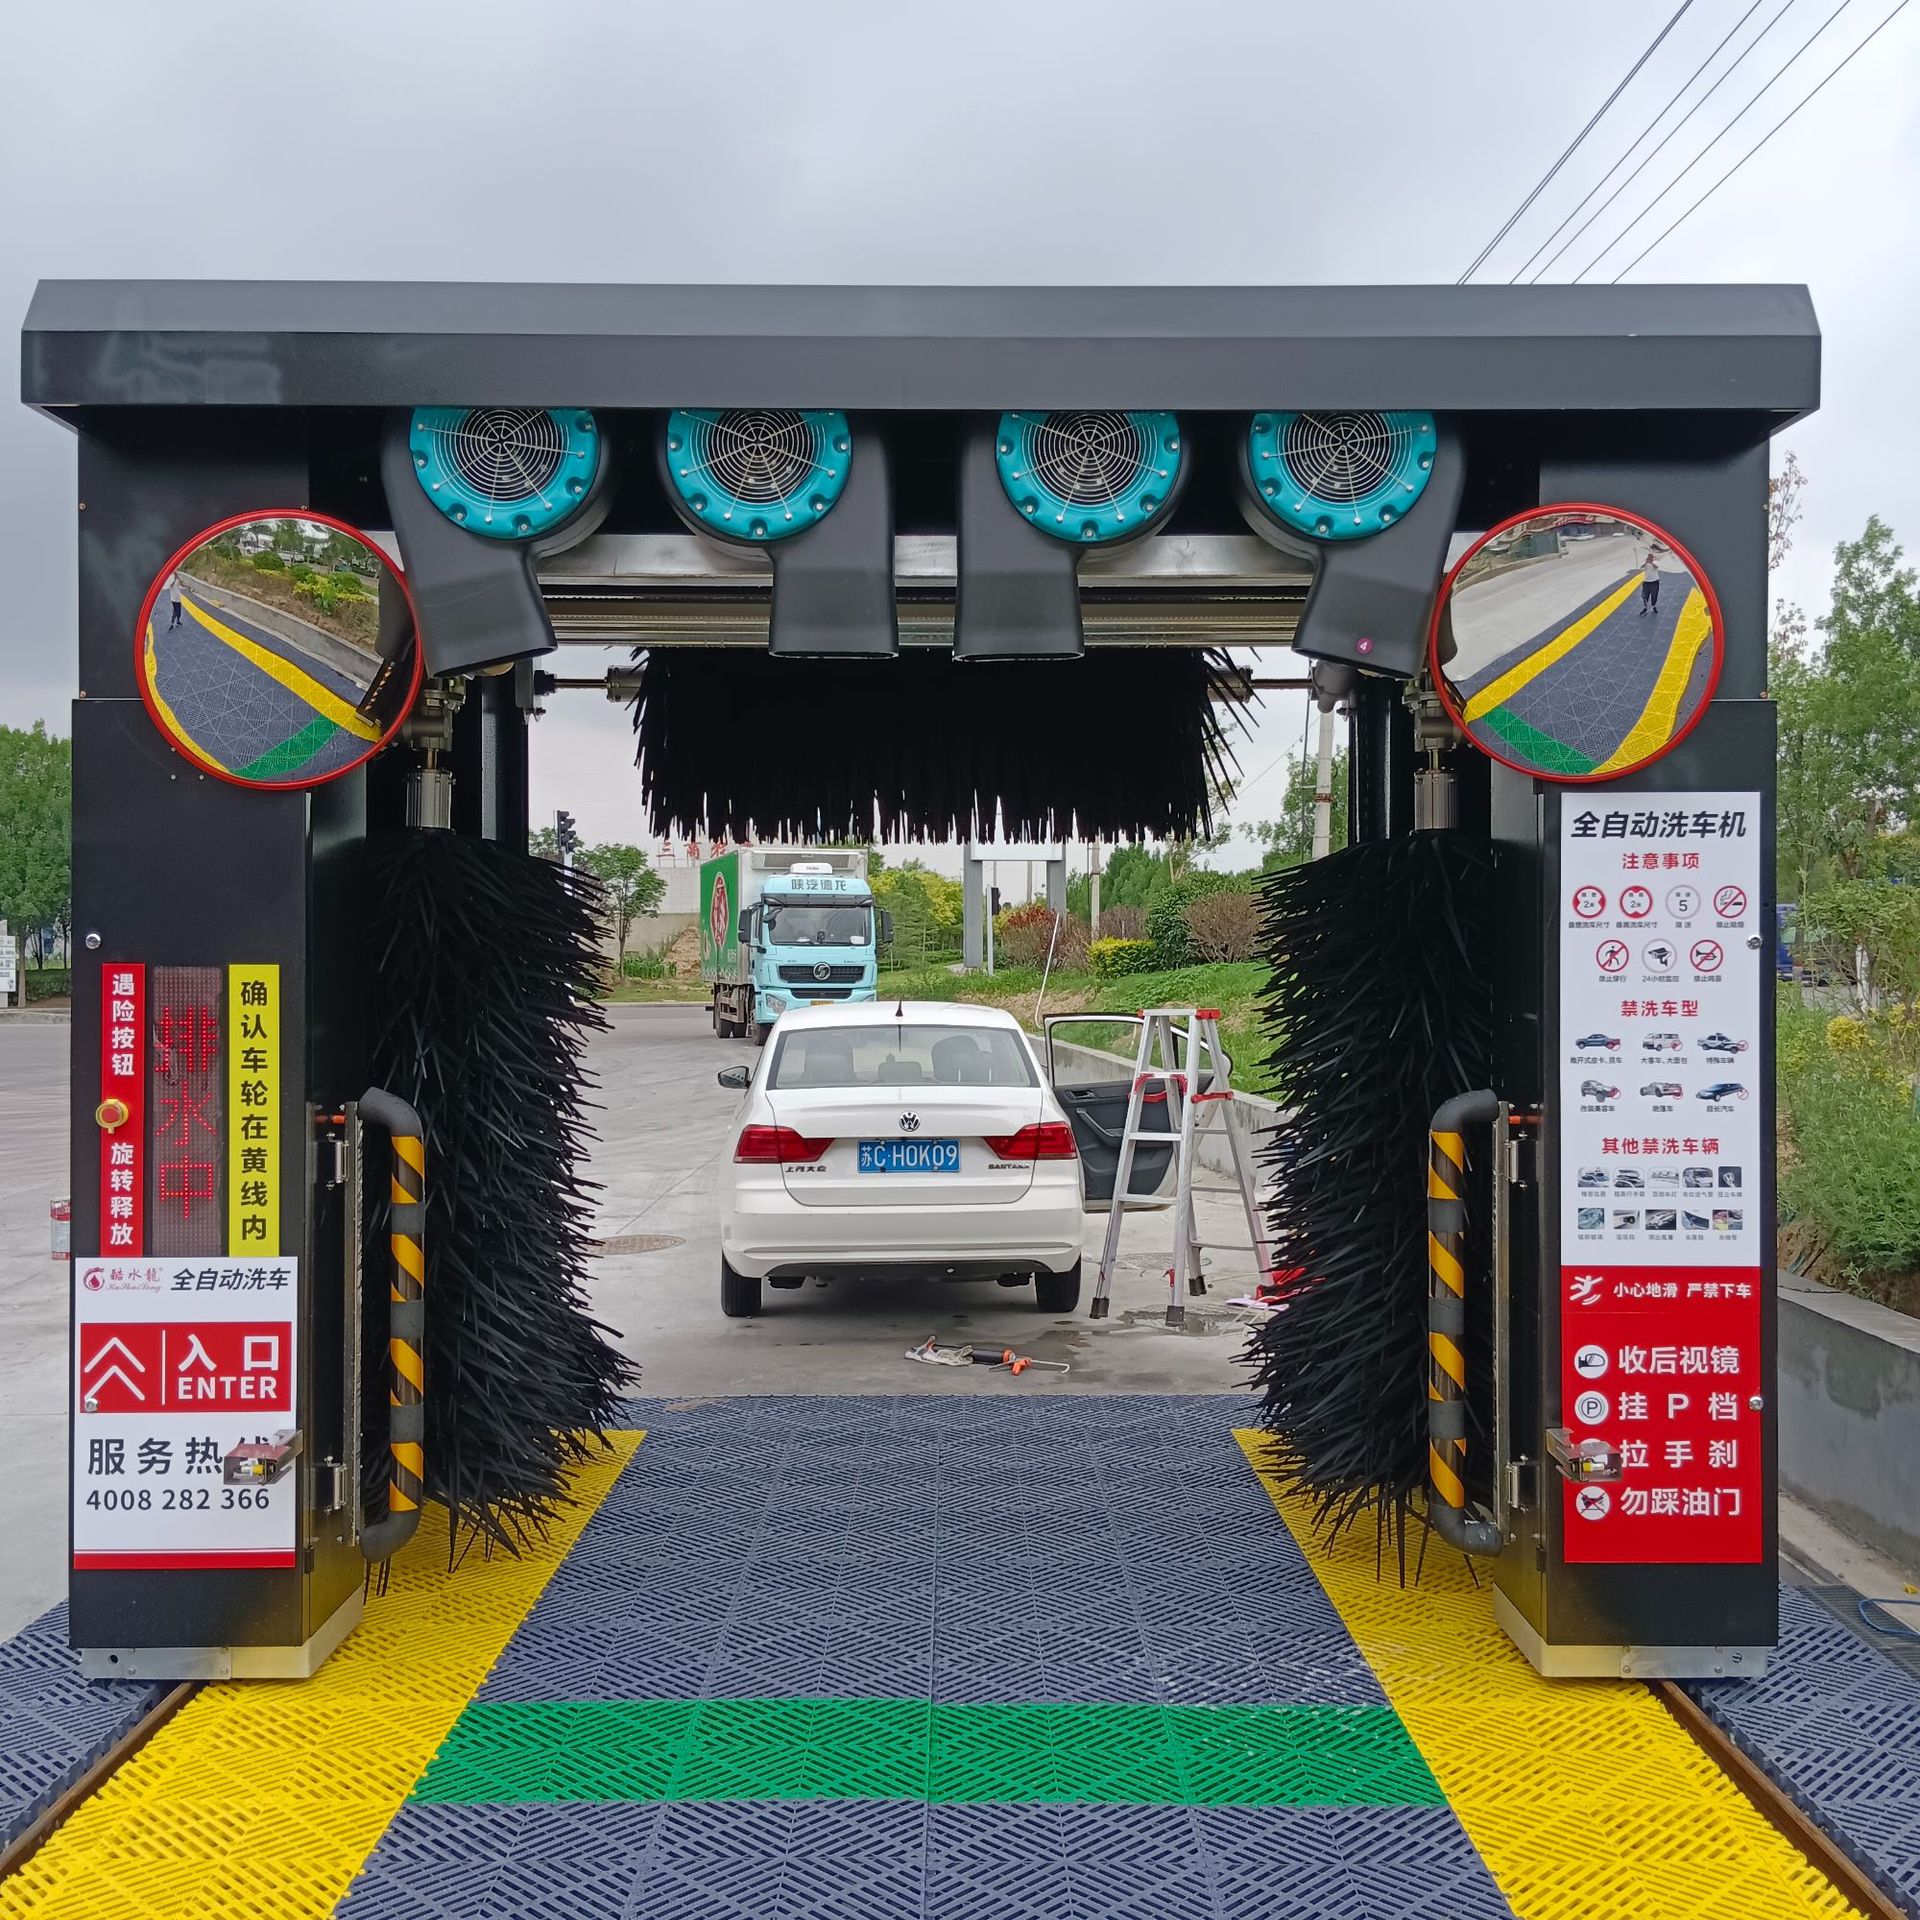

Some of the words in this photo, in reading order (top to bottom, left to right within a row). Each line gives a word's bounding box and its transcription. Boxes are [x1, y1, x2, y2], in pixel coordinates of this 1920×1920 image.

[1571, 811, 1746, 838] 全自动洗车机
[1622, 853, 1700, 869] 注意事项
[791, 879, 847, 891] 陕汽德龙
[1678, 899, 1688, 912] 5
[1621, 1000, 1698, 1017] 禁洗车型
[111, 973, 135, 1076] 遇险按钮
[154, 1006, 217, 1219] 排水中
[240, 979, 268, 1241] 确认车轮在黄线内
[1602, 1138, 1720, 1155] 其他禁洗车辆
[110, 1142, 135, 1246] 旋转释放
[170, 1267, 291, 1291] 全自动洗车
[1613, 1282, 1678, 1298] 小心地滑
[1686, 1282, 1751, 1298] 严禁下车
[178, 1333, 280, 1372] 入口
[1618, 1346, 1740, 1375] 收后视镜
[178, 1376, 277, 1399] ENTER
[88, 1436, 269, 1475] 服务热
[86, 1489, 152, 1511] 4008
[162, 1488, 211, 1510] 282
[220, 1488, 270, 1509] 366
[1620, 1488, 1741, 1516] 勿踩油门
